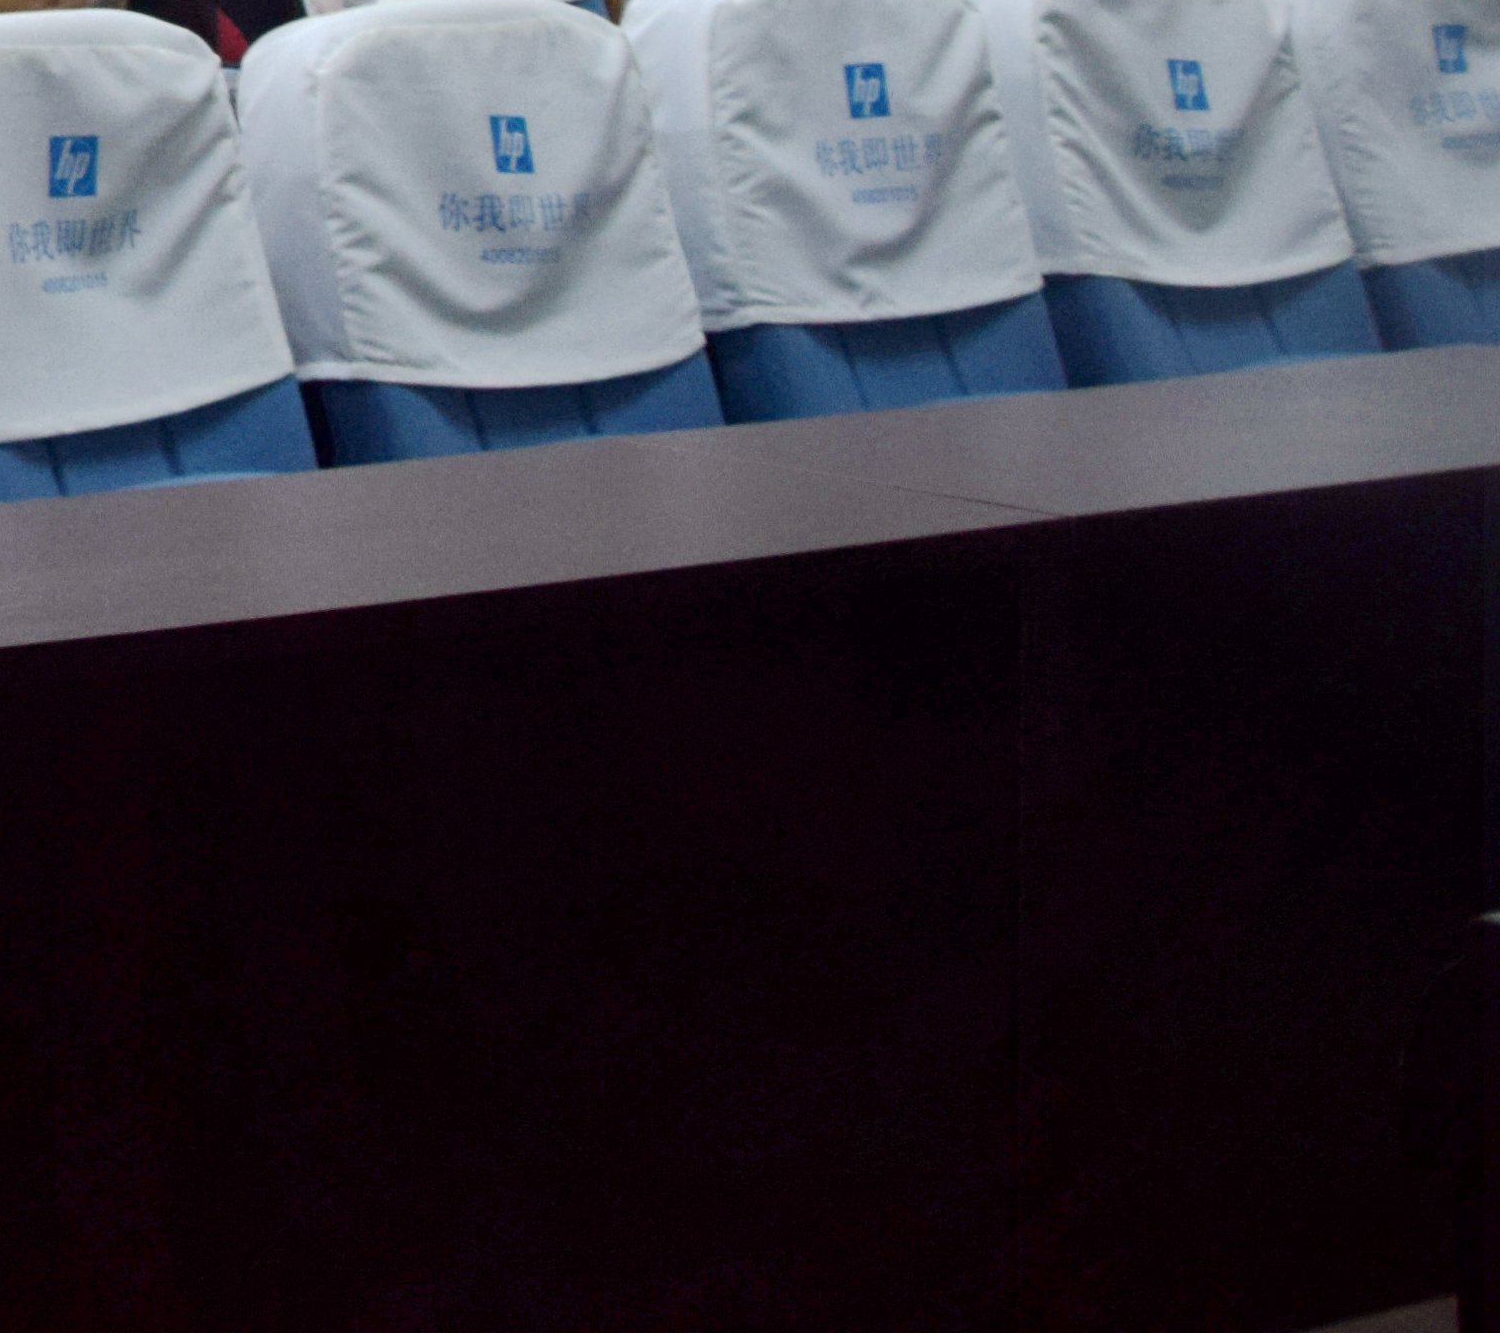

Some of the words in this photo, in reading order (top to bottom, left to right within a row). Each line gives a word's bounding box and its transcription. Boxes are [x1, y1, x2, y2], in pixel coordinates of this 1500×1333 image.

[850, 64, 884, 119] hp
[1173, 61, 1205, 111] hp
[55, 138, 93, 197] hp
[495, 117, 529, 173] hp
